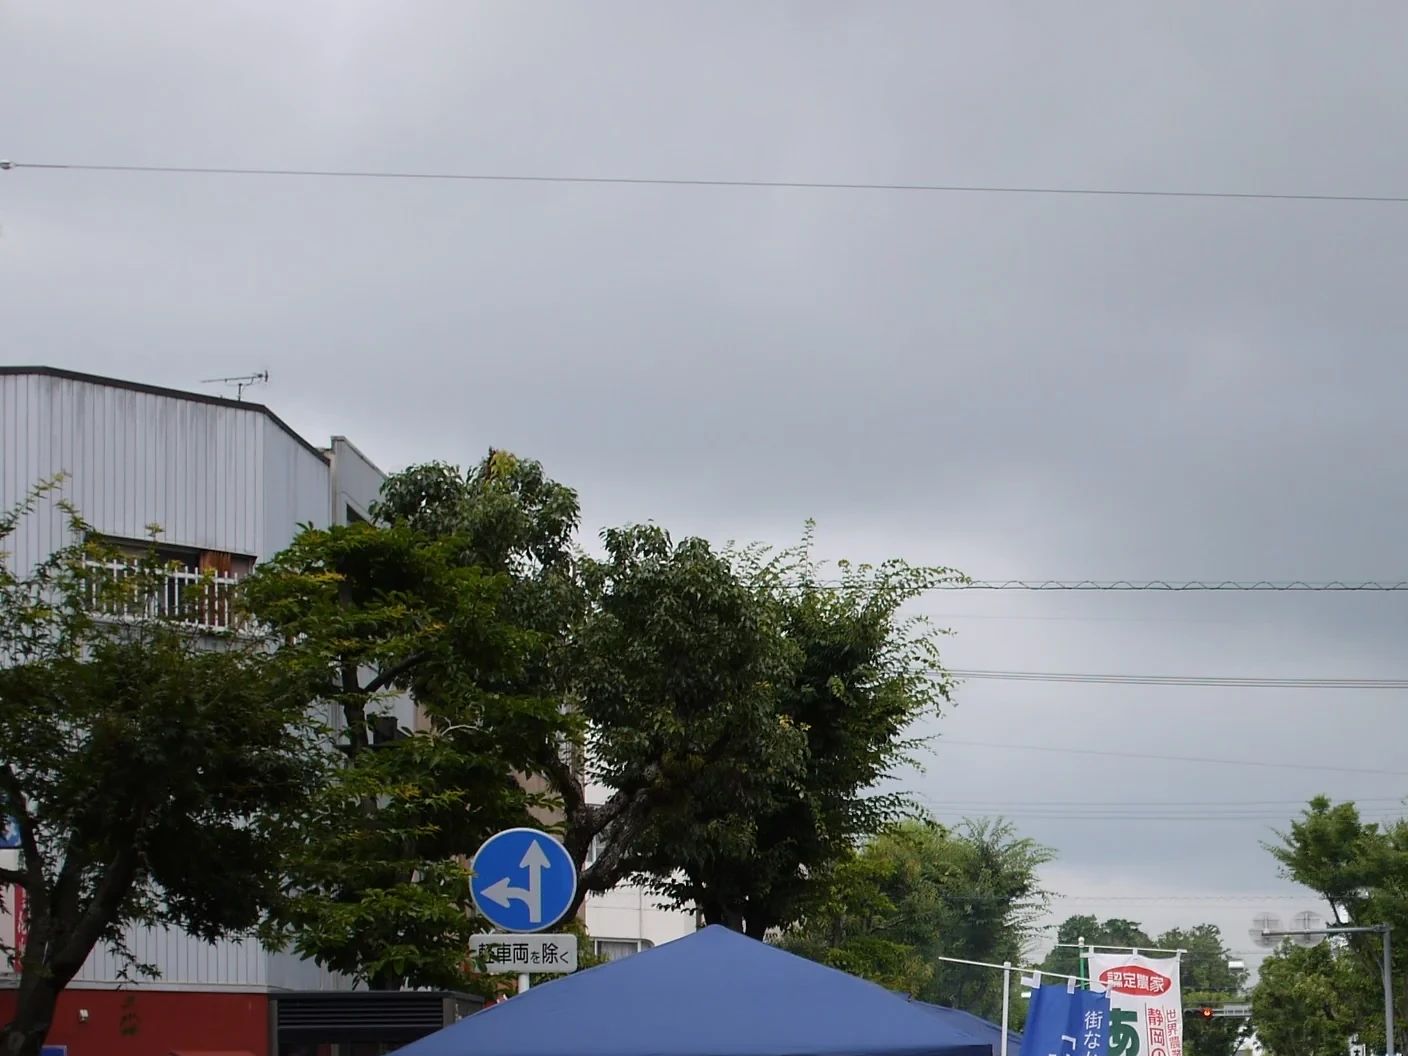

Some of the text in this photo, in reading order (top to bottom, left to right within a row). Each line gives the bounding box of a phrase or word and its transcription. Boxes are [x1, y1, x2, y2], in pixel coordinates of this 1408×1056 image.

[478, 942, 569, 965] 軽車両を除く
